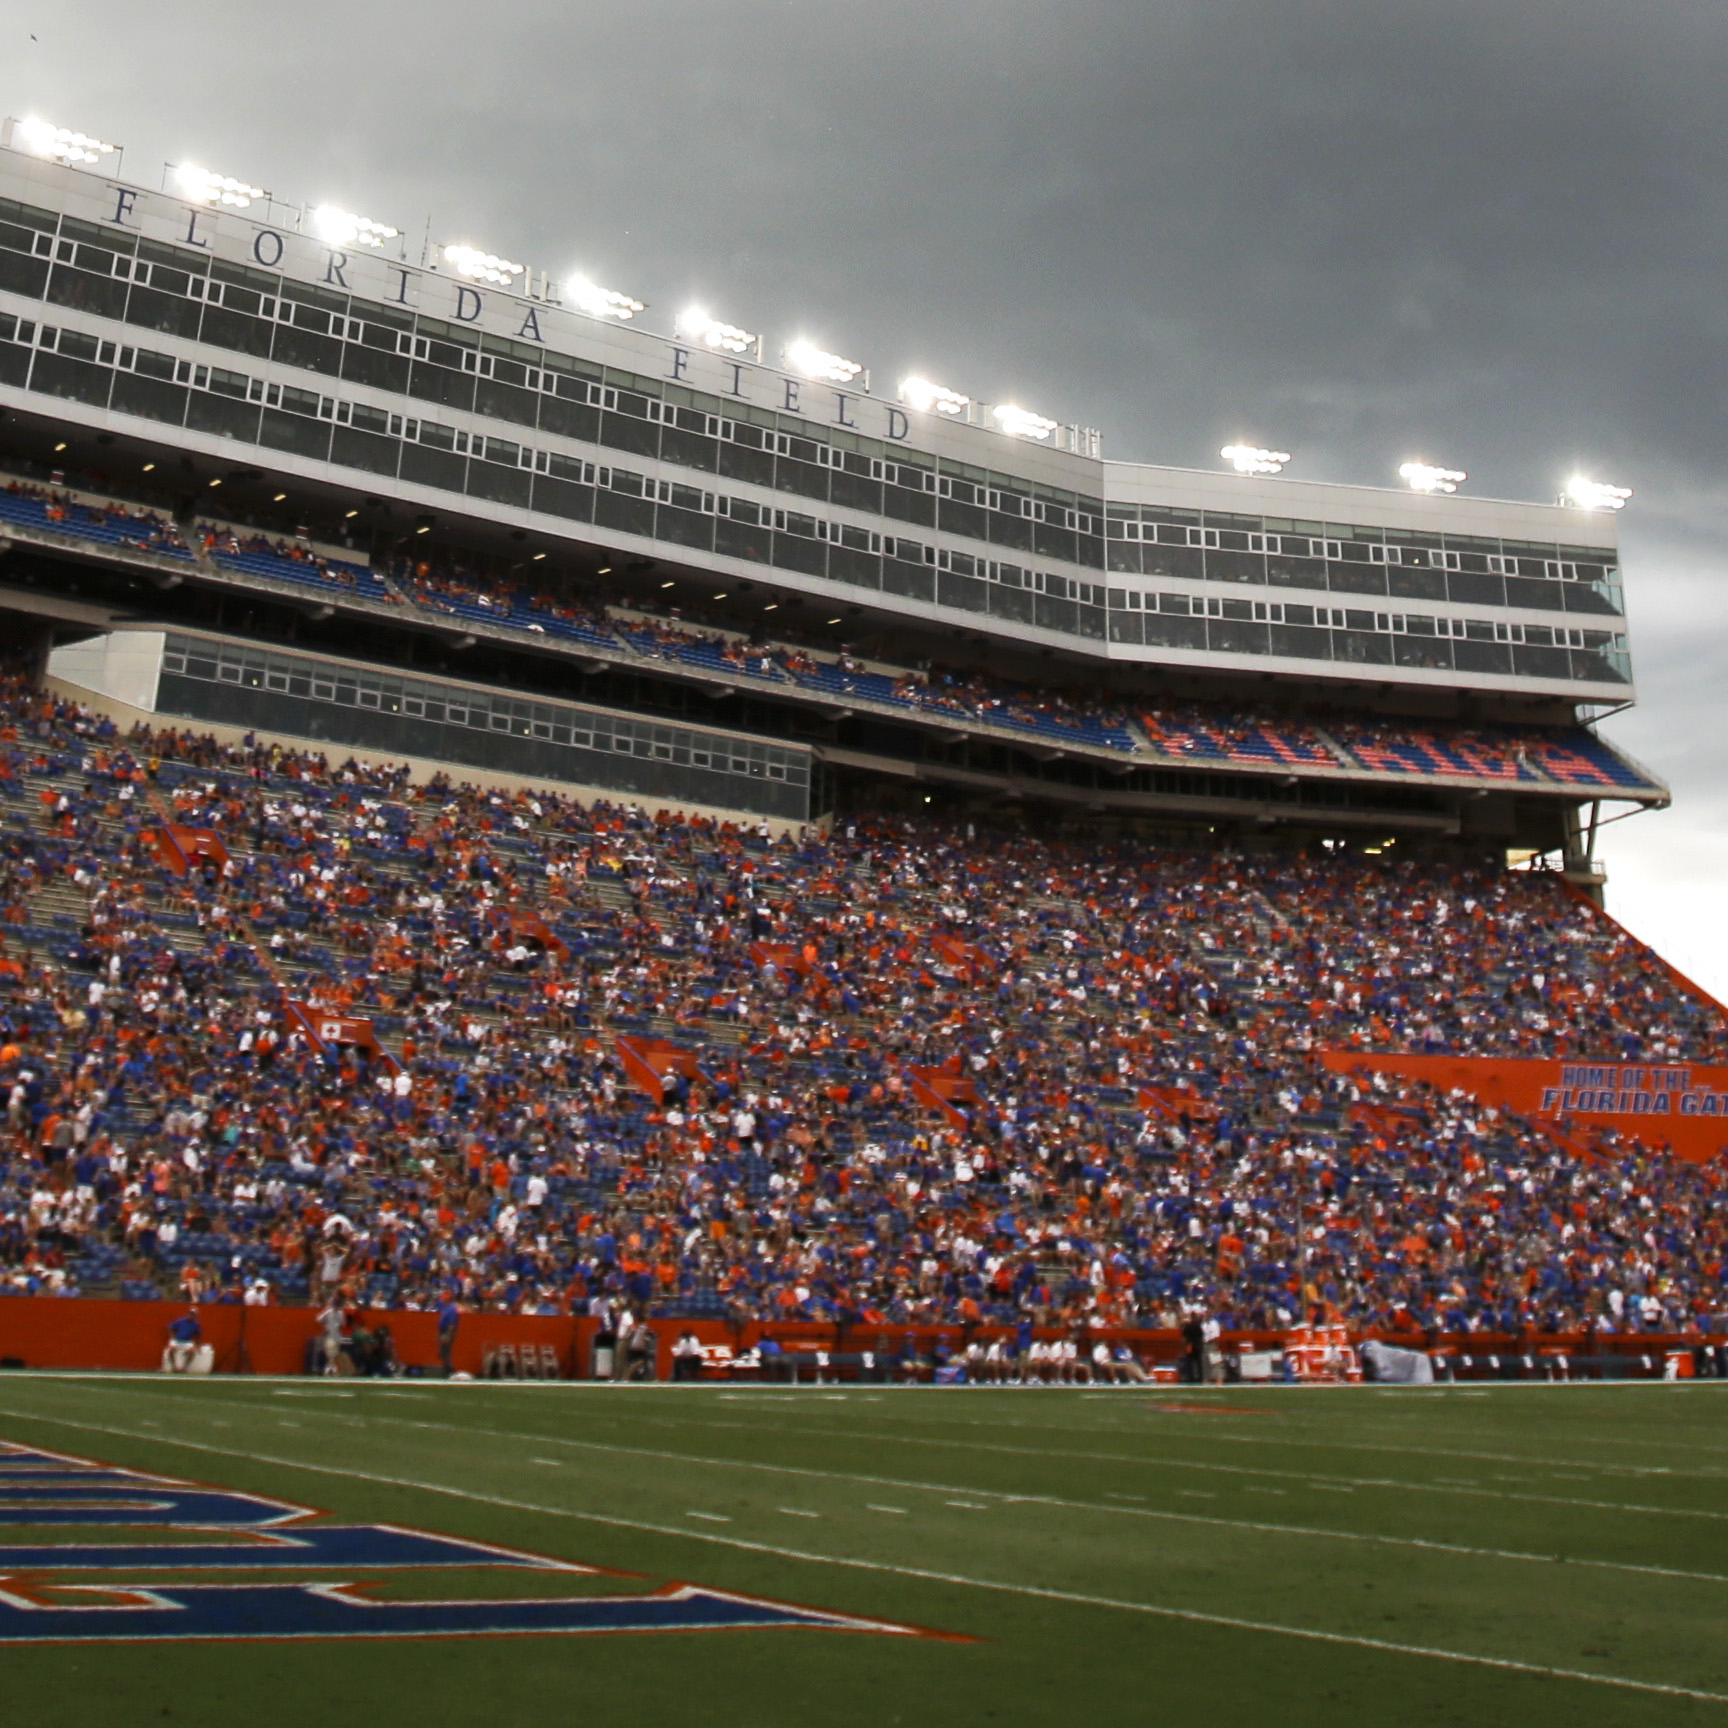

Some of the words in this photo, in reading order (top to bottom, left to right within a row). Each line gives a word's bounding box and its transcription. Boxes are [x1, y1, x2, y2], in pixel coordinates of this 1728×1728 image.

[111, 187, 545, 343] FLORIDA
[671, 348, 909, 440] FIELD
[1561, 1065, 1618, 1088] HOME
[1622, 1067, 1646, 1089] OF
[1541, 1087, 1671, 1115] FLORIDA
